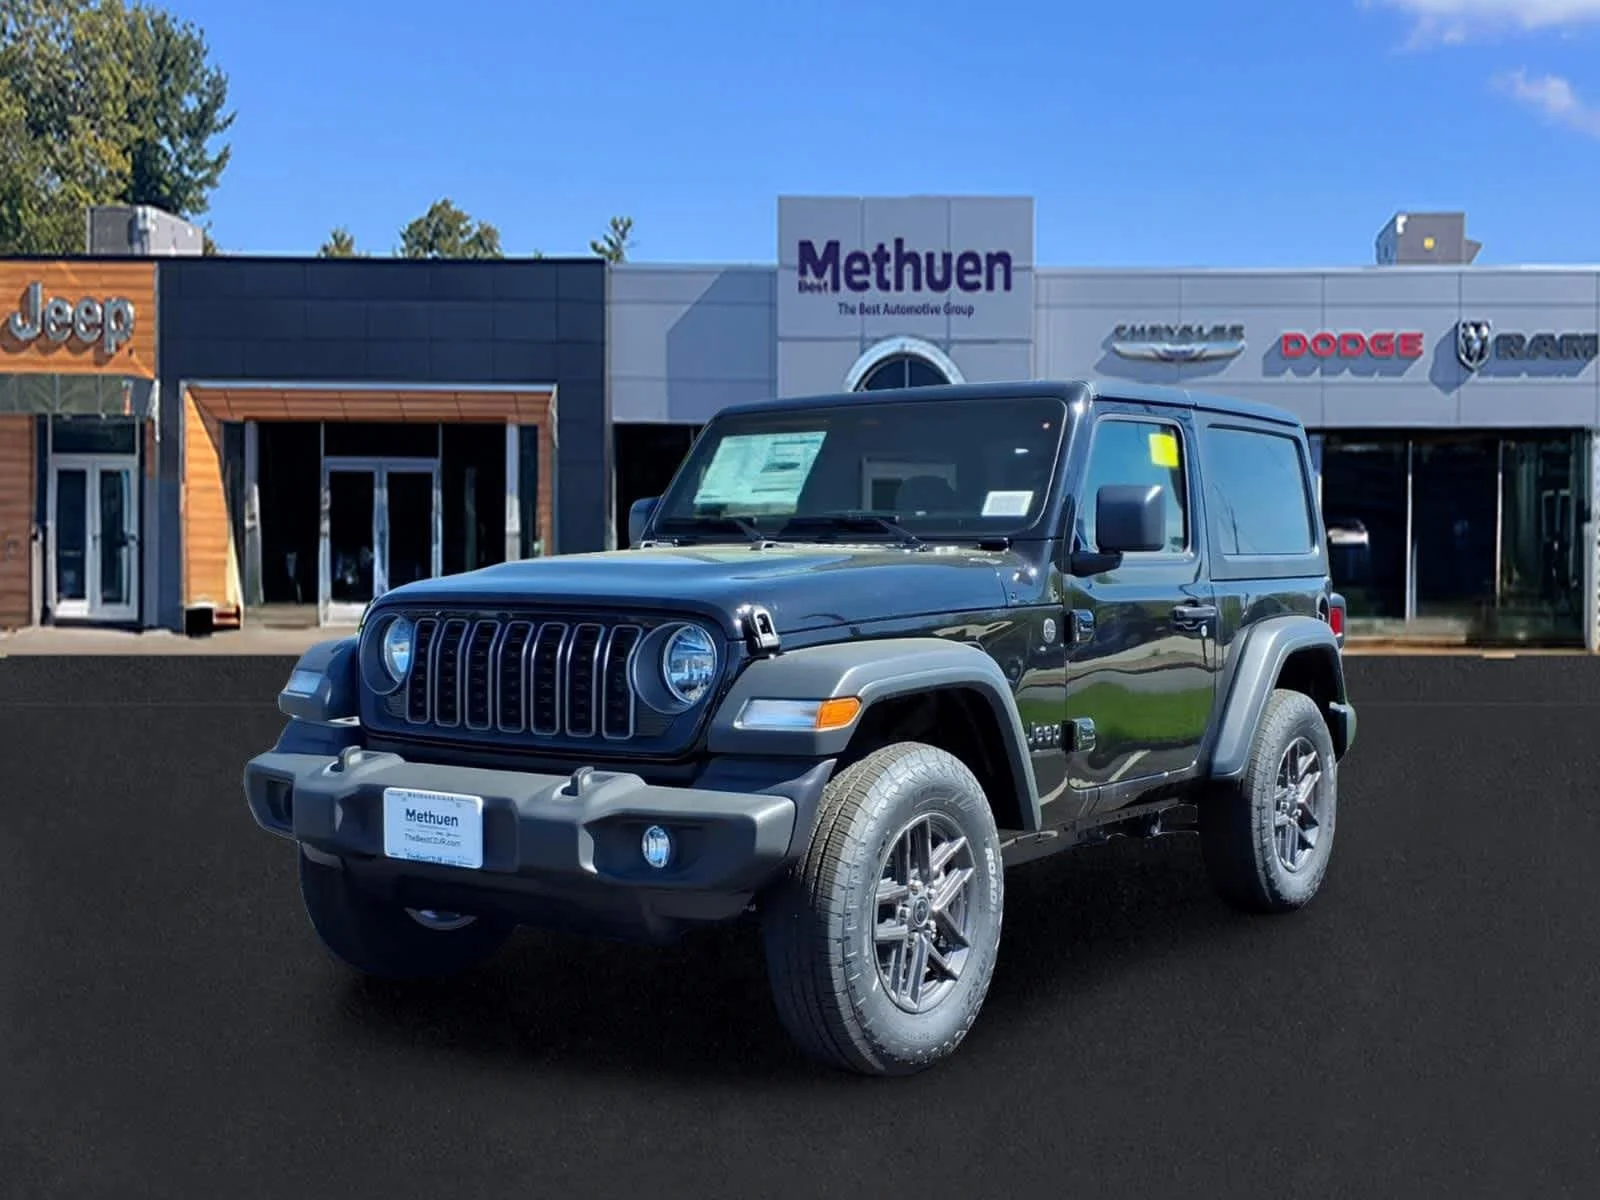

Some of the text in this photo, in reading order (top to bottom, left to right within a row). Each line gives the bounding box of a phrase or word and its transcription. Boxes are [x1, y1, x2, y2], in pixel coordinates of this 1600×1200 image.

[798, 237, 1012, 292] Methuen
[8, 281, 135, 354] Jeep
[838, 301, 974, 318] The Best Automotive Group
[1282, 332, 1424, 357] DODGE
[1494, 333, 1598, 360] RAM
[1026, 722, 1060, 745] Jeep
[405, 808, 459, 827] Methuen
